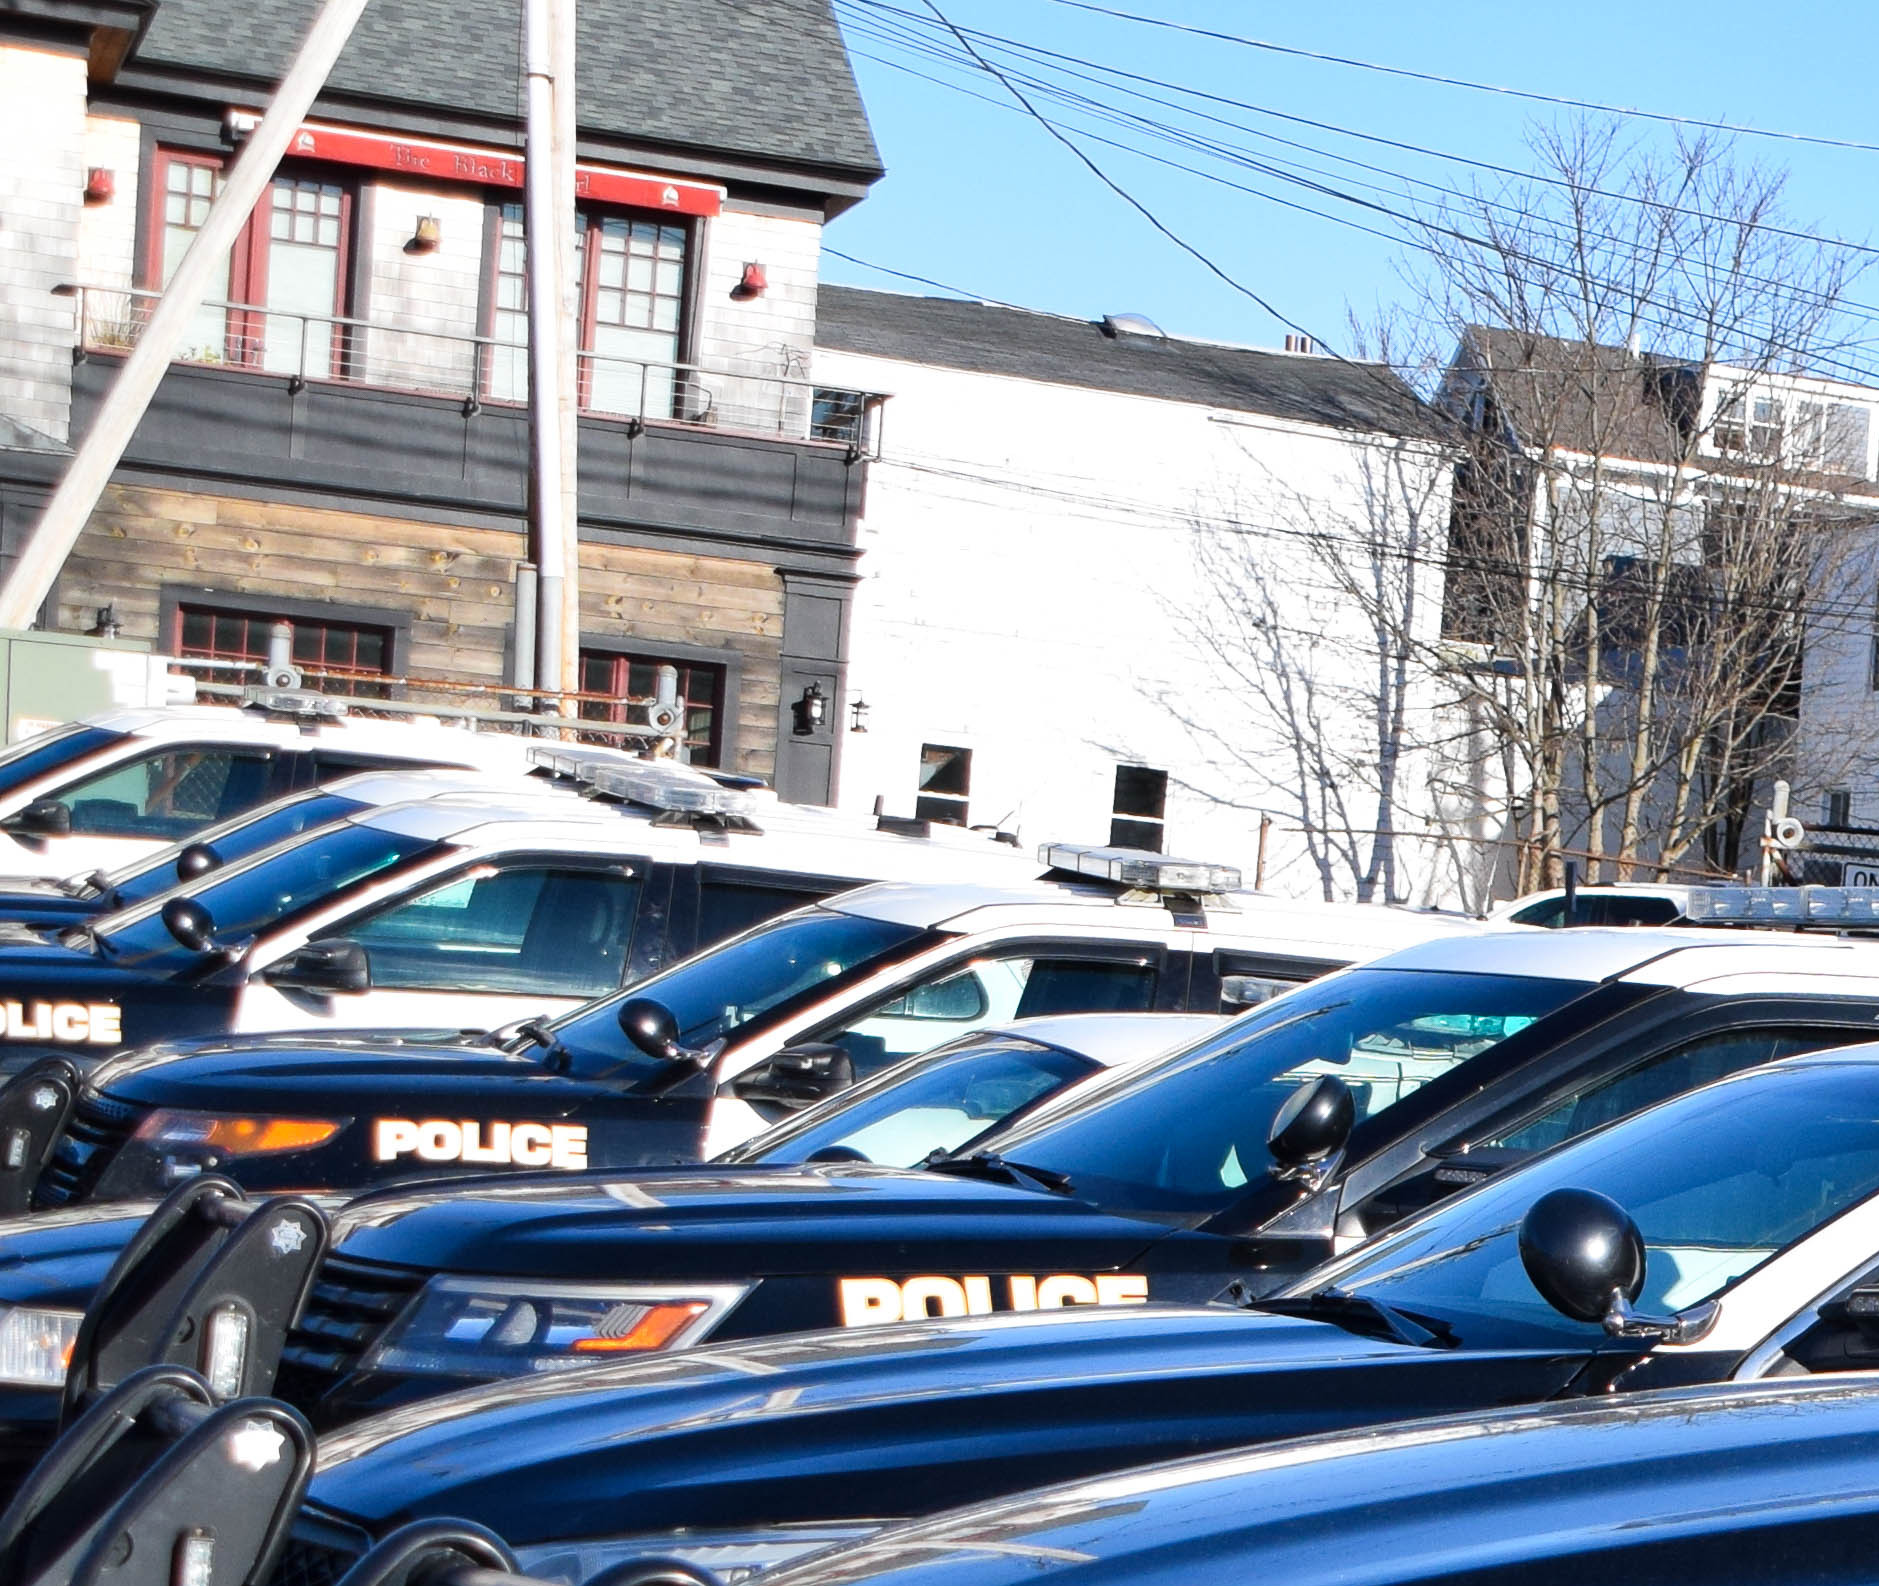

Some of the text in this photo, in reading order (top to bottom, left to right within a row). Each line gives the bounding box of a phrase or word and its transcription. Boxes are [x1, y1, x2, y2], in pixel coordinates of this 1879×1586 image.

[453, 155, 515, 183] Black
[0, 1000, 122, 1044] LICE
[374, 1118, 588, 1170] POLICE
